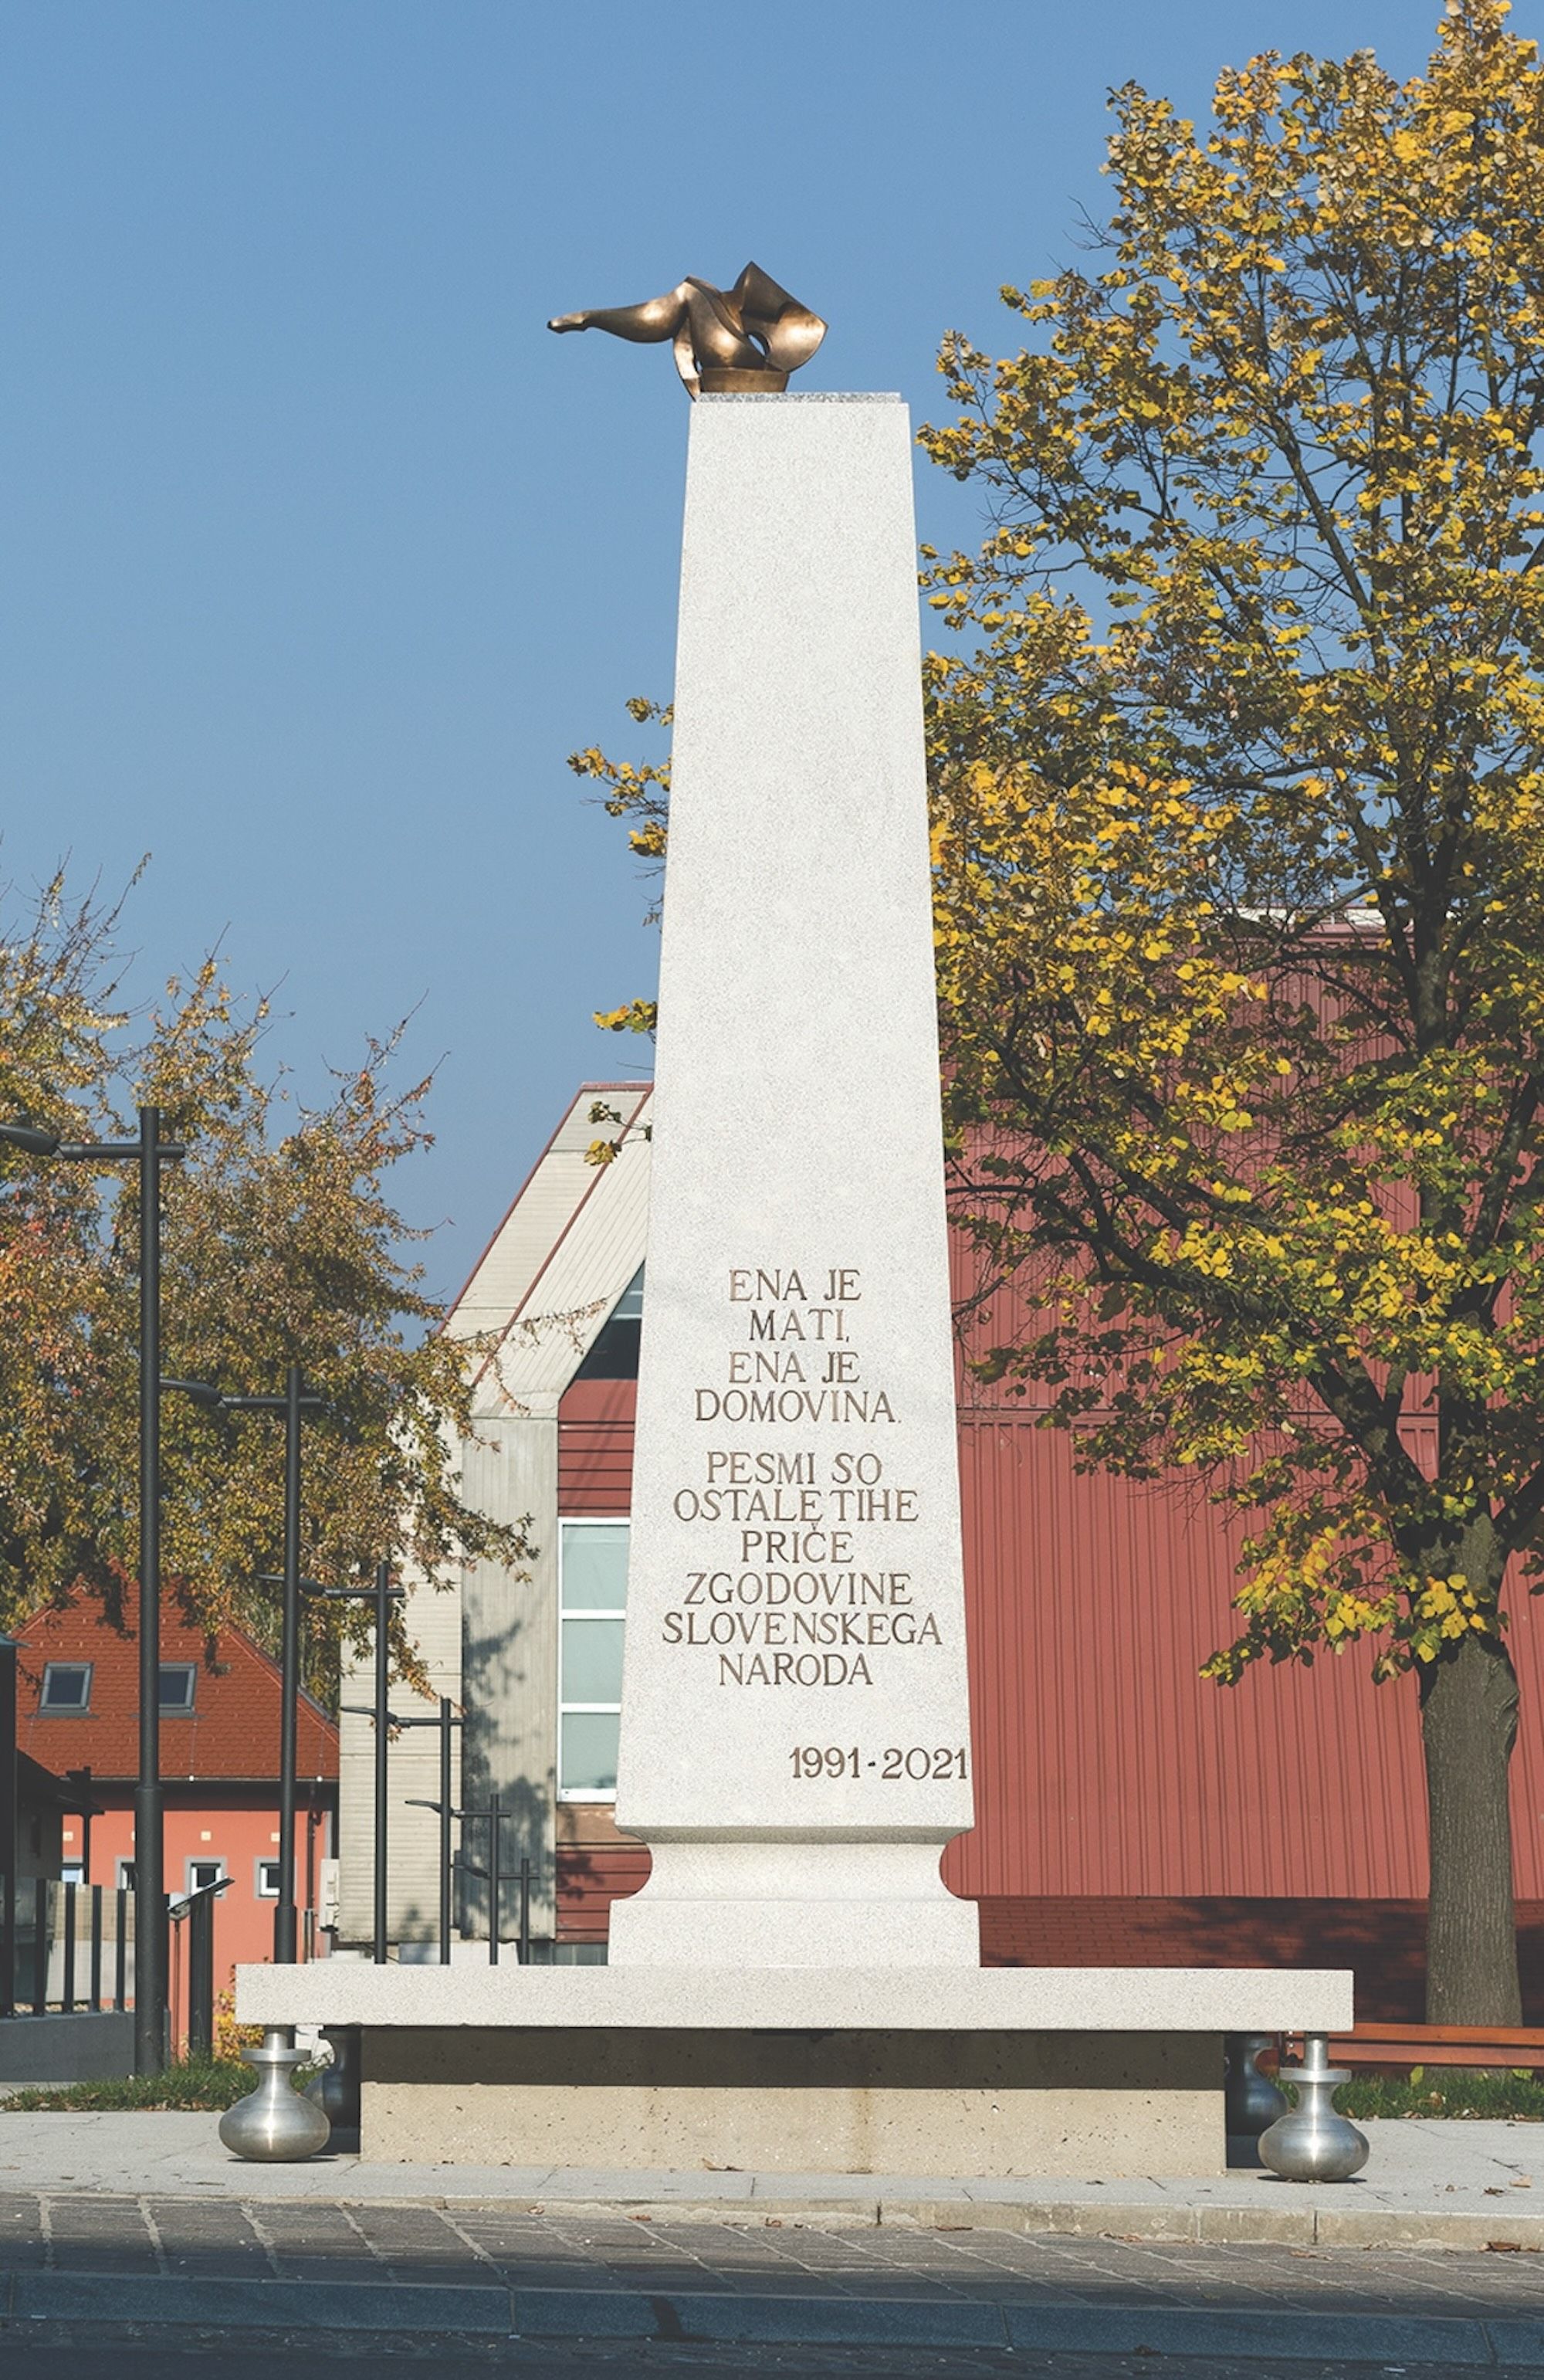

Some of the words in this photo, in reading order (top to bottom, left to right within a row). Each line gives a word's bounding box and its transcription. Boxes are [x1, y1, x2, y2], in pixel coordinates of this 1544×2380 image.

[729, 1269, 807, 1302] ENA
[824, 1269, 861, 1302] JE
[750, 1309, 850, 1343] MATI,
[729, 1351, 806, 1383] ENA
[822, 1351, 860, 1383] JE
[707, 1452, 815, 1484] PESMI
[832, 1453, 882, 1485] SO
[674, 1490, 823, 1522] OSTALE
[825, 1490, 919, 1522] TIHE
[741, 1523, 853, 1564] PRIČE
[684, 1573, 913, 1605] ZGODOVINE
[662, 1612, 942, 1646] SLOVENSKEGA
[720, 1653, 872, 1686] NARODA
